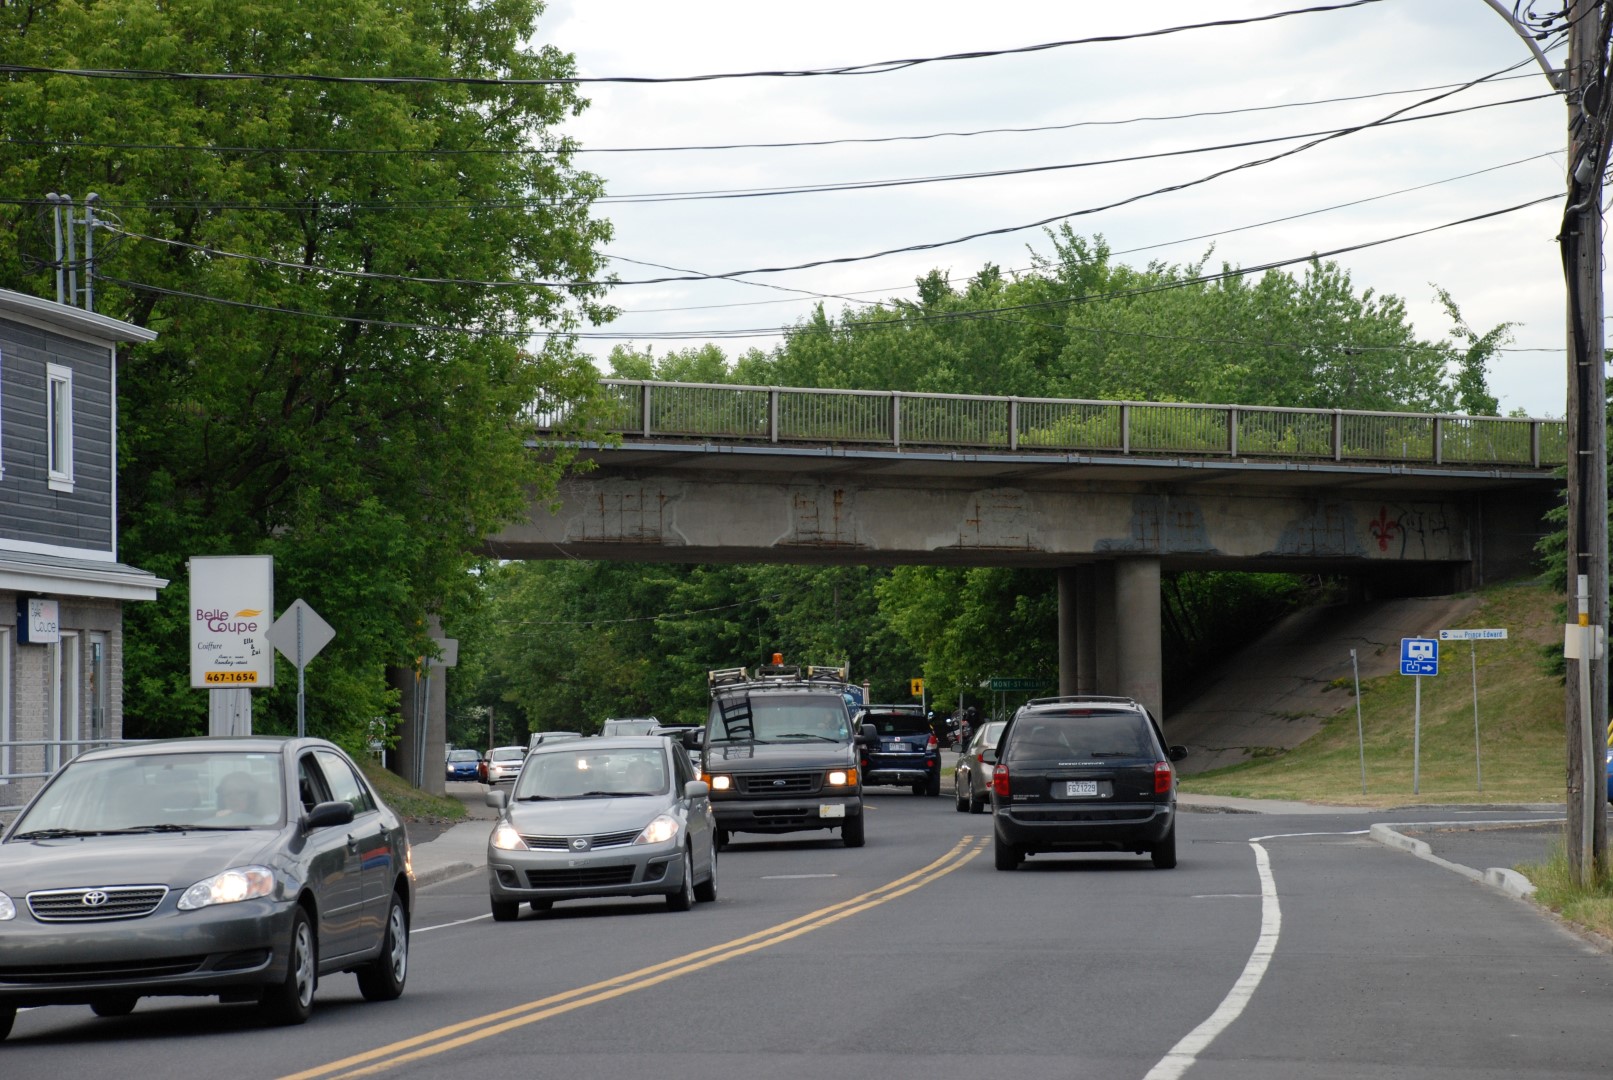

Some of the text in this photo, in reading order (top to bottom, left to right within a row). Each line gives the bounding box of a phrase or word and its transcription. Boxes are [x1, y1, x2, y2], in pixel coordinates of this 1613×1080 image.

[196, 609, 229, 621] Belle
[208, 617, 257, 635] Coupe
[1483, 630, 1503, 638] Edward
[197, 641, 222, 651] Coiffure
[206, 674, 254, 682] 467-1654
[1068, 784, 1096, 792] FGZ1229
